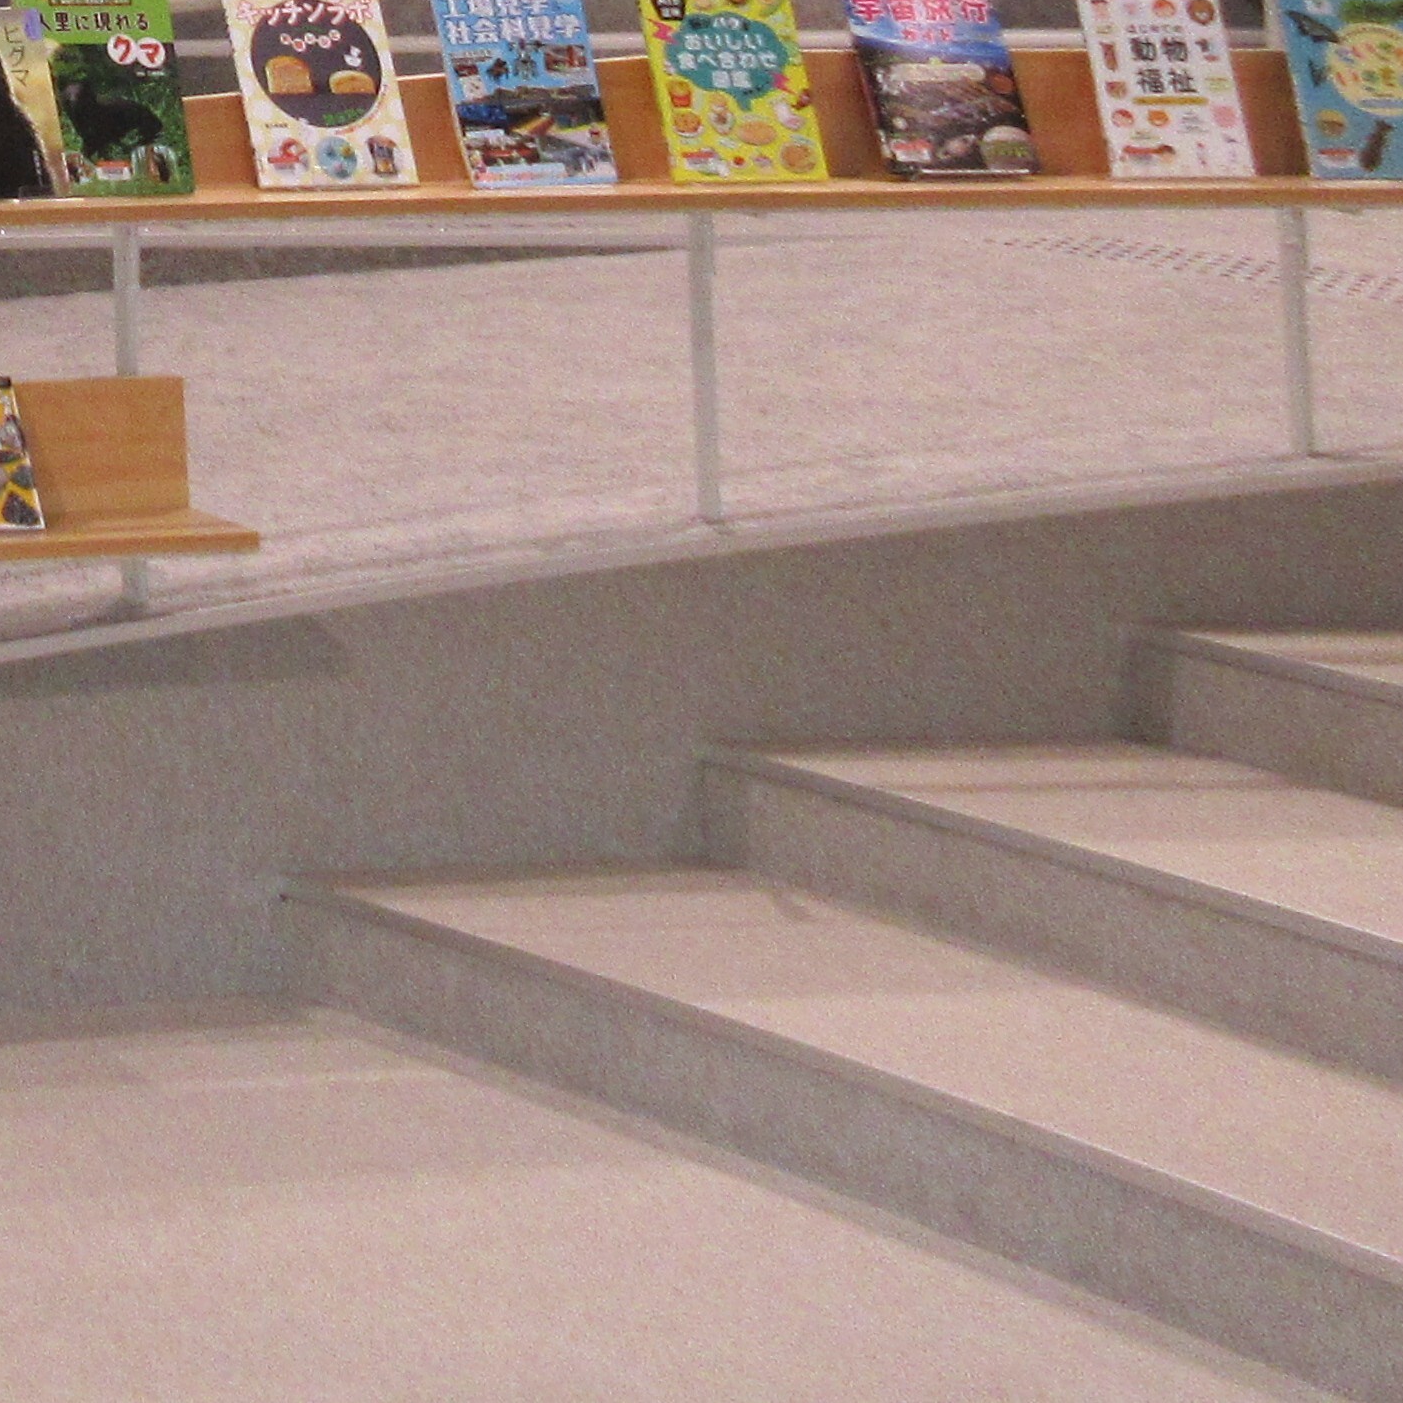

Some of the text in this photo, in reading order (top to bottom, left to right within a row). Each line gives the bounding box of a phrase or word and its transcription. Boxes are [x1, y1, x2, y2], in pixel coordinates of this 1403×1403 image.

[4, 25, 30, 87] ヒグマ
[113, 36, 161, 64] クマ
